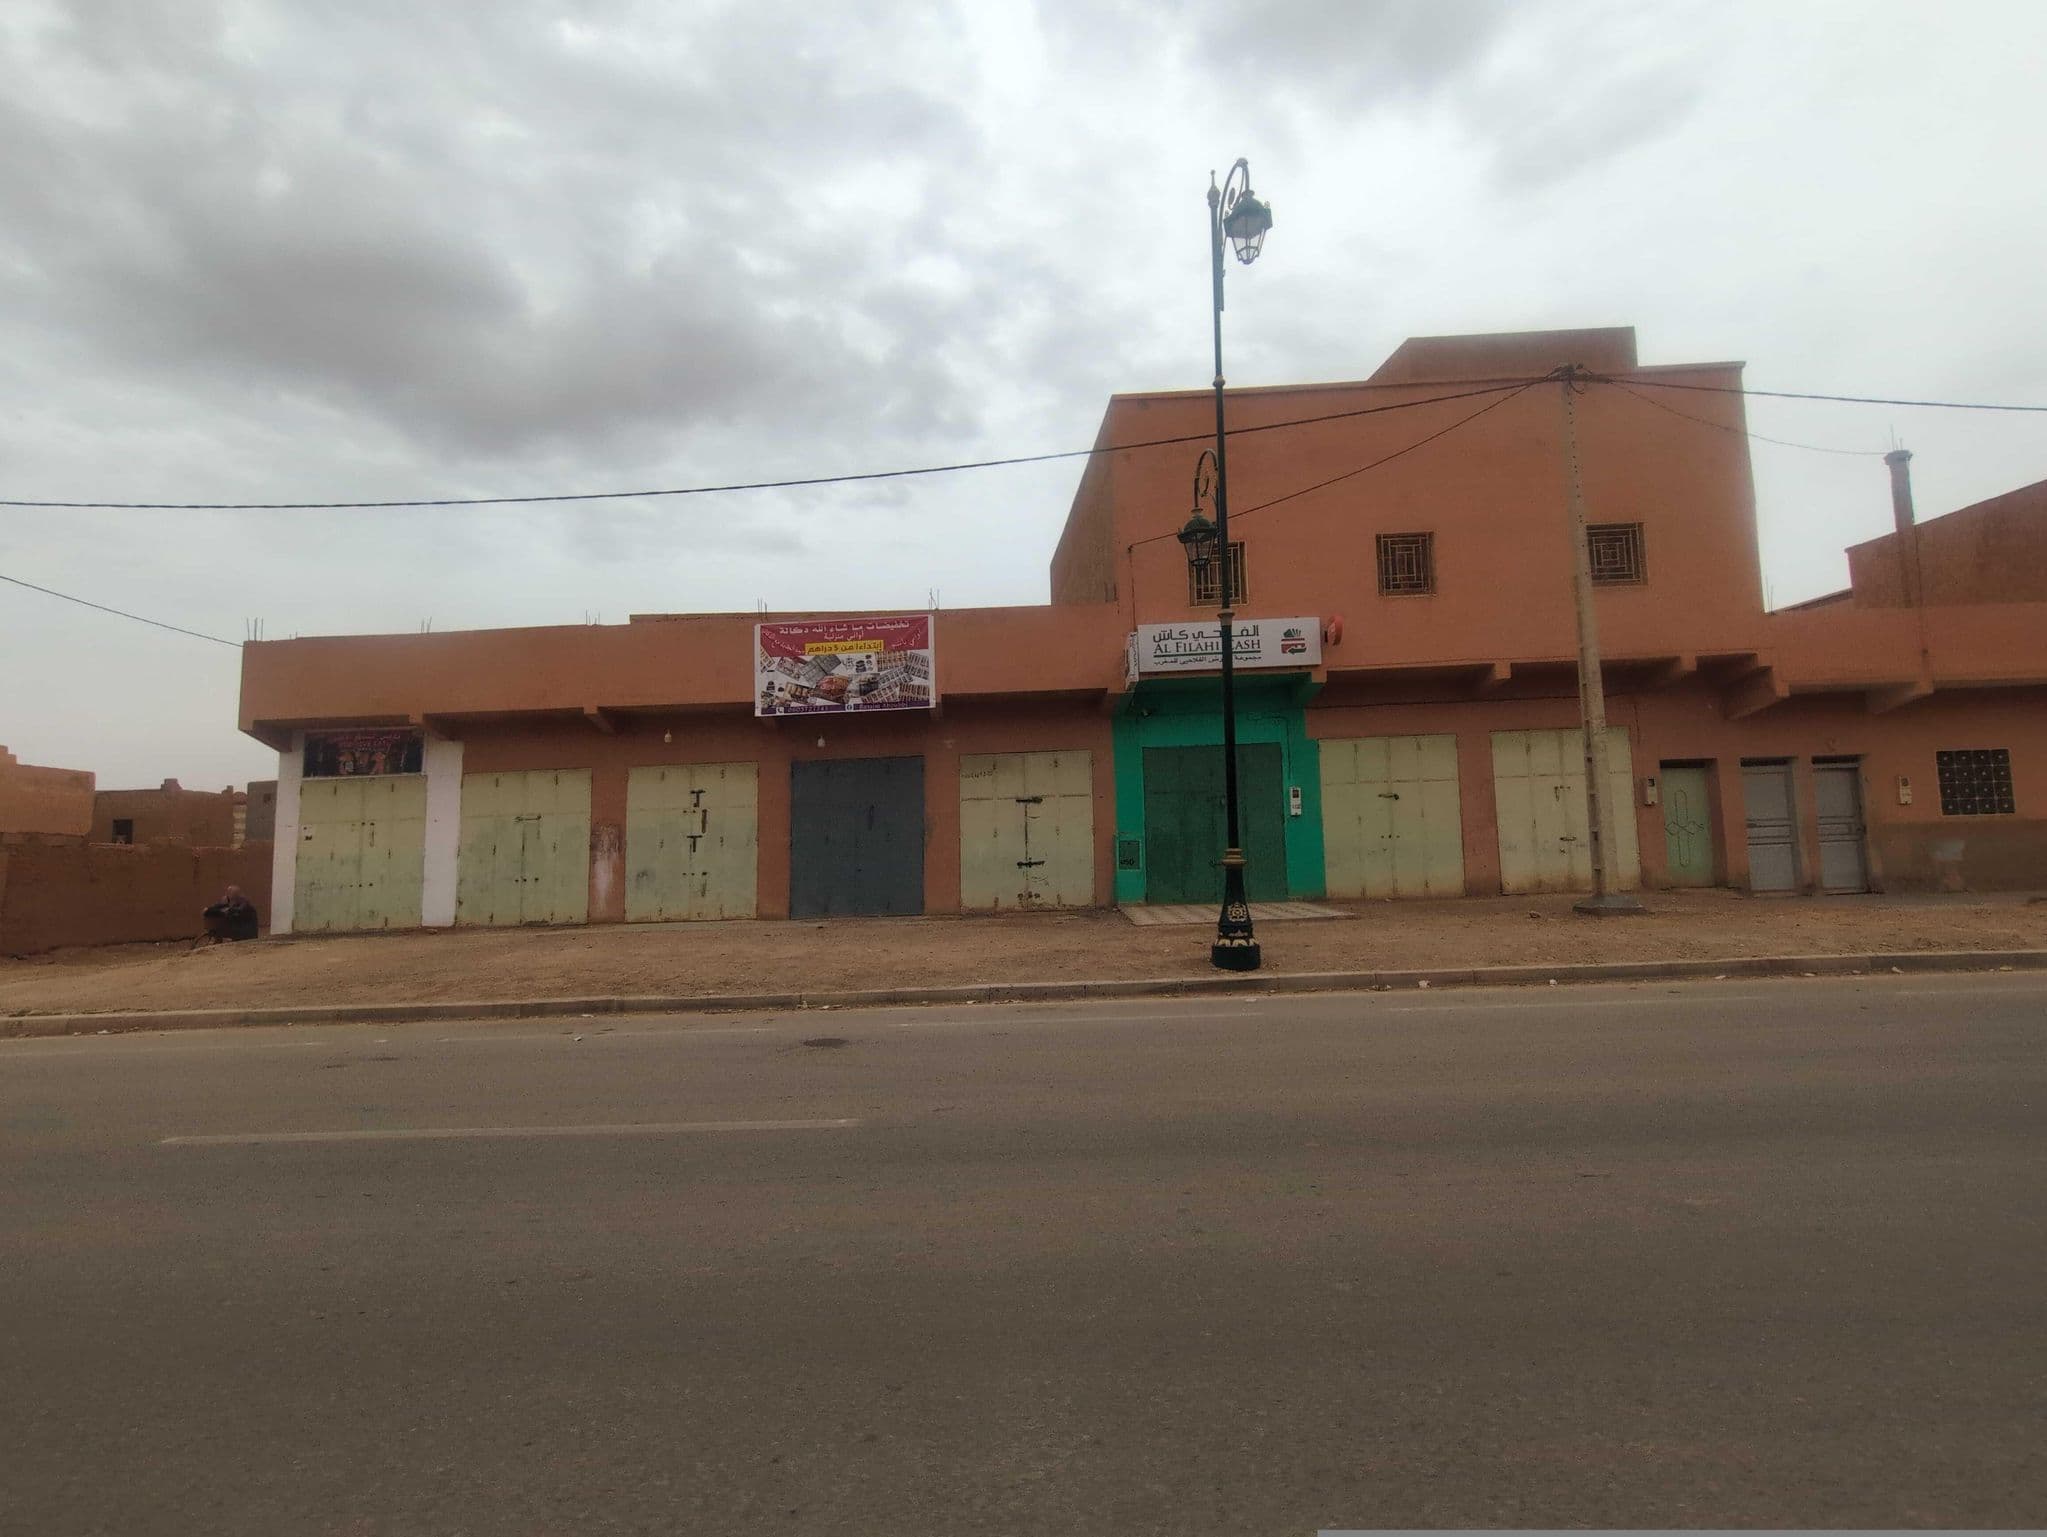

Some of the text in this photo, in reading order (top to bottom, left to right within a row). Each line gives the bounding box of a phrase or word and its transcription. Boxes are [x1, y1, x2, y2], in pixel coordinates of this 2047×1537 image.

[830, 624, 848, 632] شاء
[1153, 629, 1189, 643] كاش
[808, 645, 833, 654] دراهم
[841, 644, 854, 652] من
[1153, 639, 1261, 654] AL FILAHI ASH
